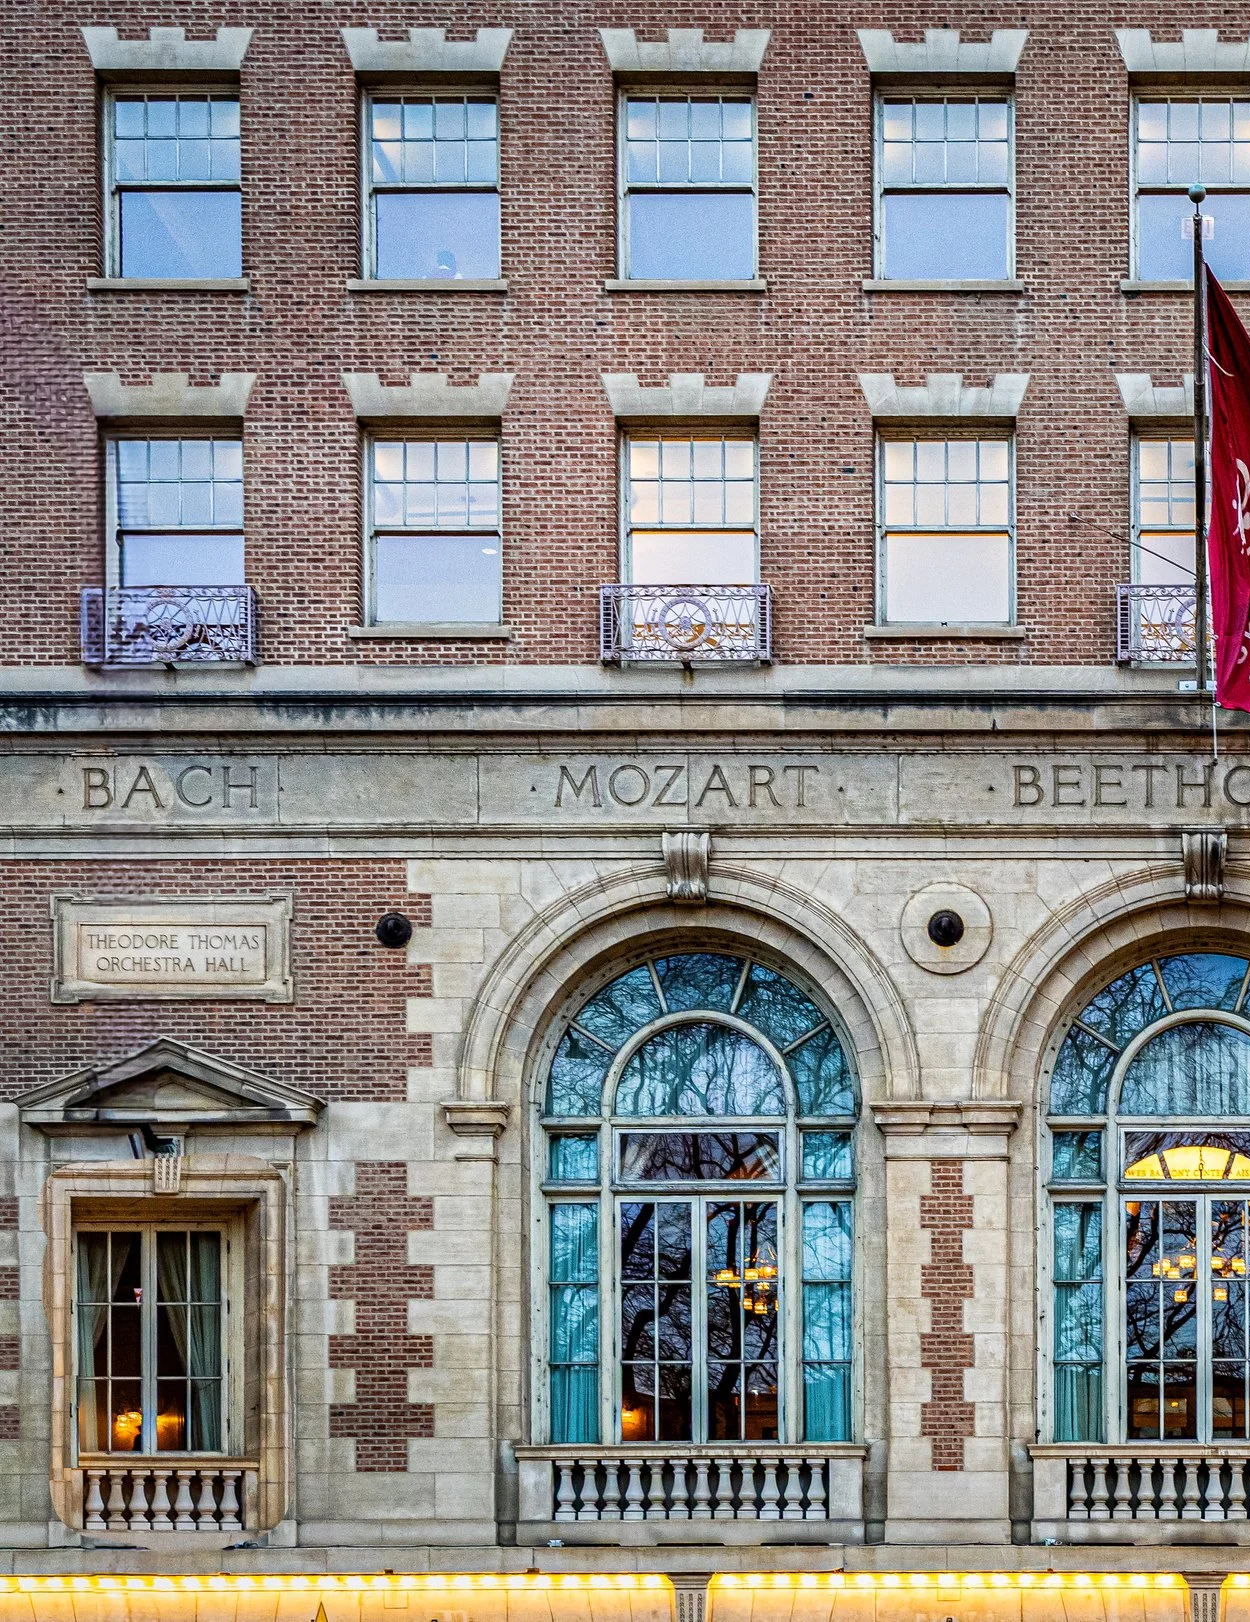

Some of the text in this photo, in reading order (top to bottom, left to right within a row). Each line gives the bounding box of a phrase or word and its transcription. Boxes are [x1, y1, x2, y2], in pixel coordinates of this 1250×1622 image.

[81, 765, 259, 809] BACH
[554, 764, 820, 808] MOZART
[87, 933, 260, 950] THEODORE THOMAS
[96, 956, 250, 972] ORCHESTRA HALL
